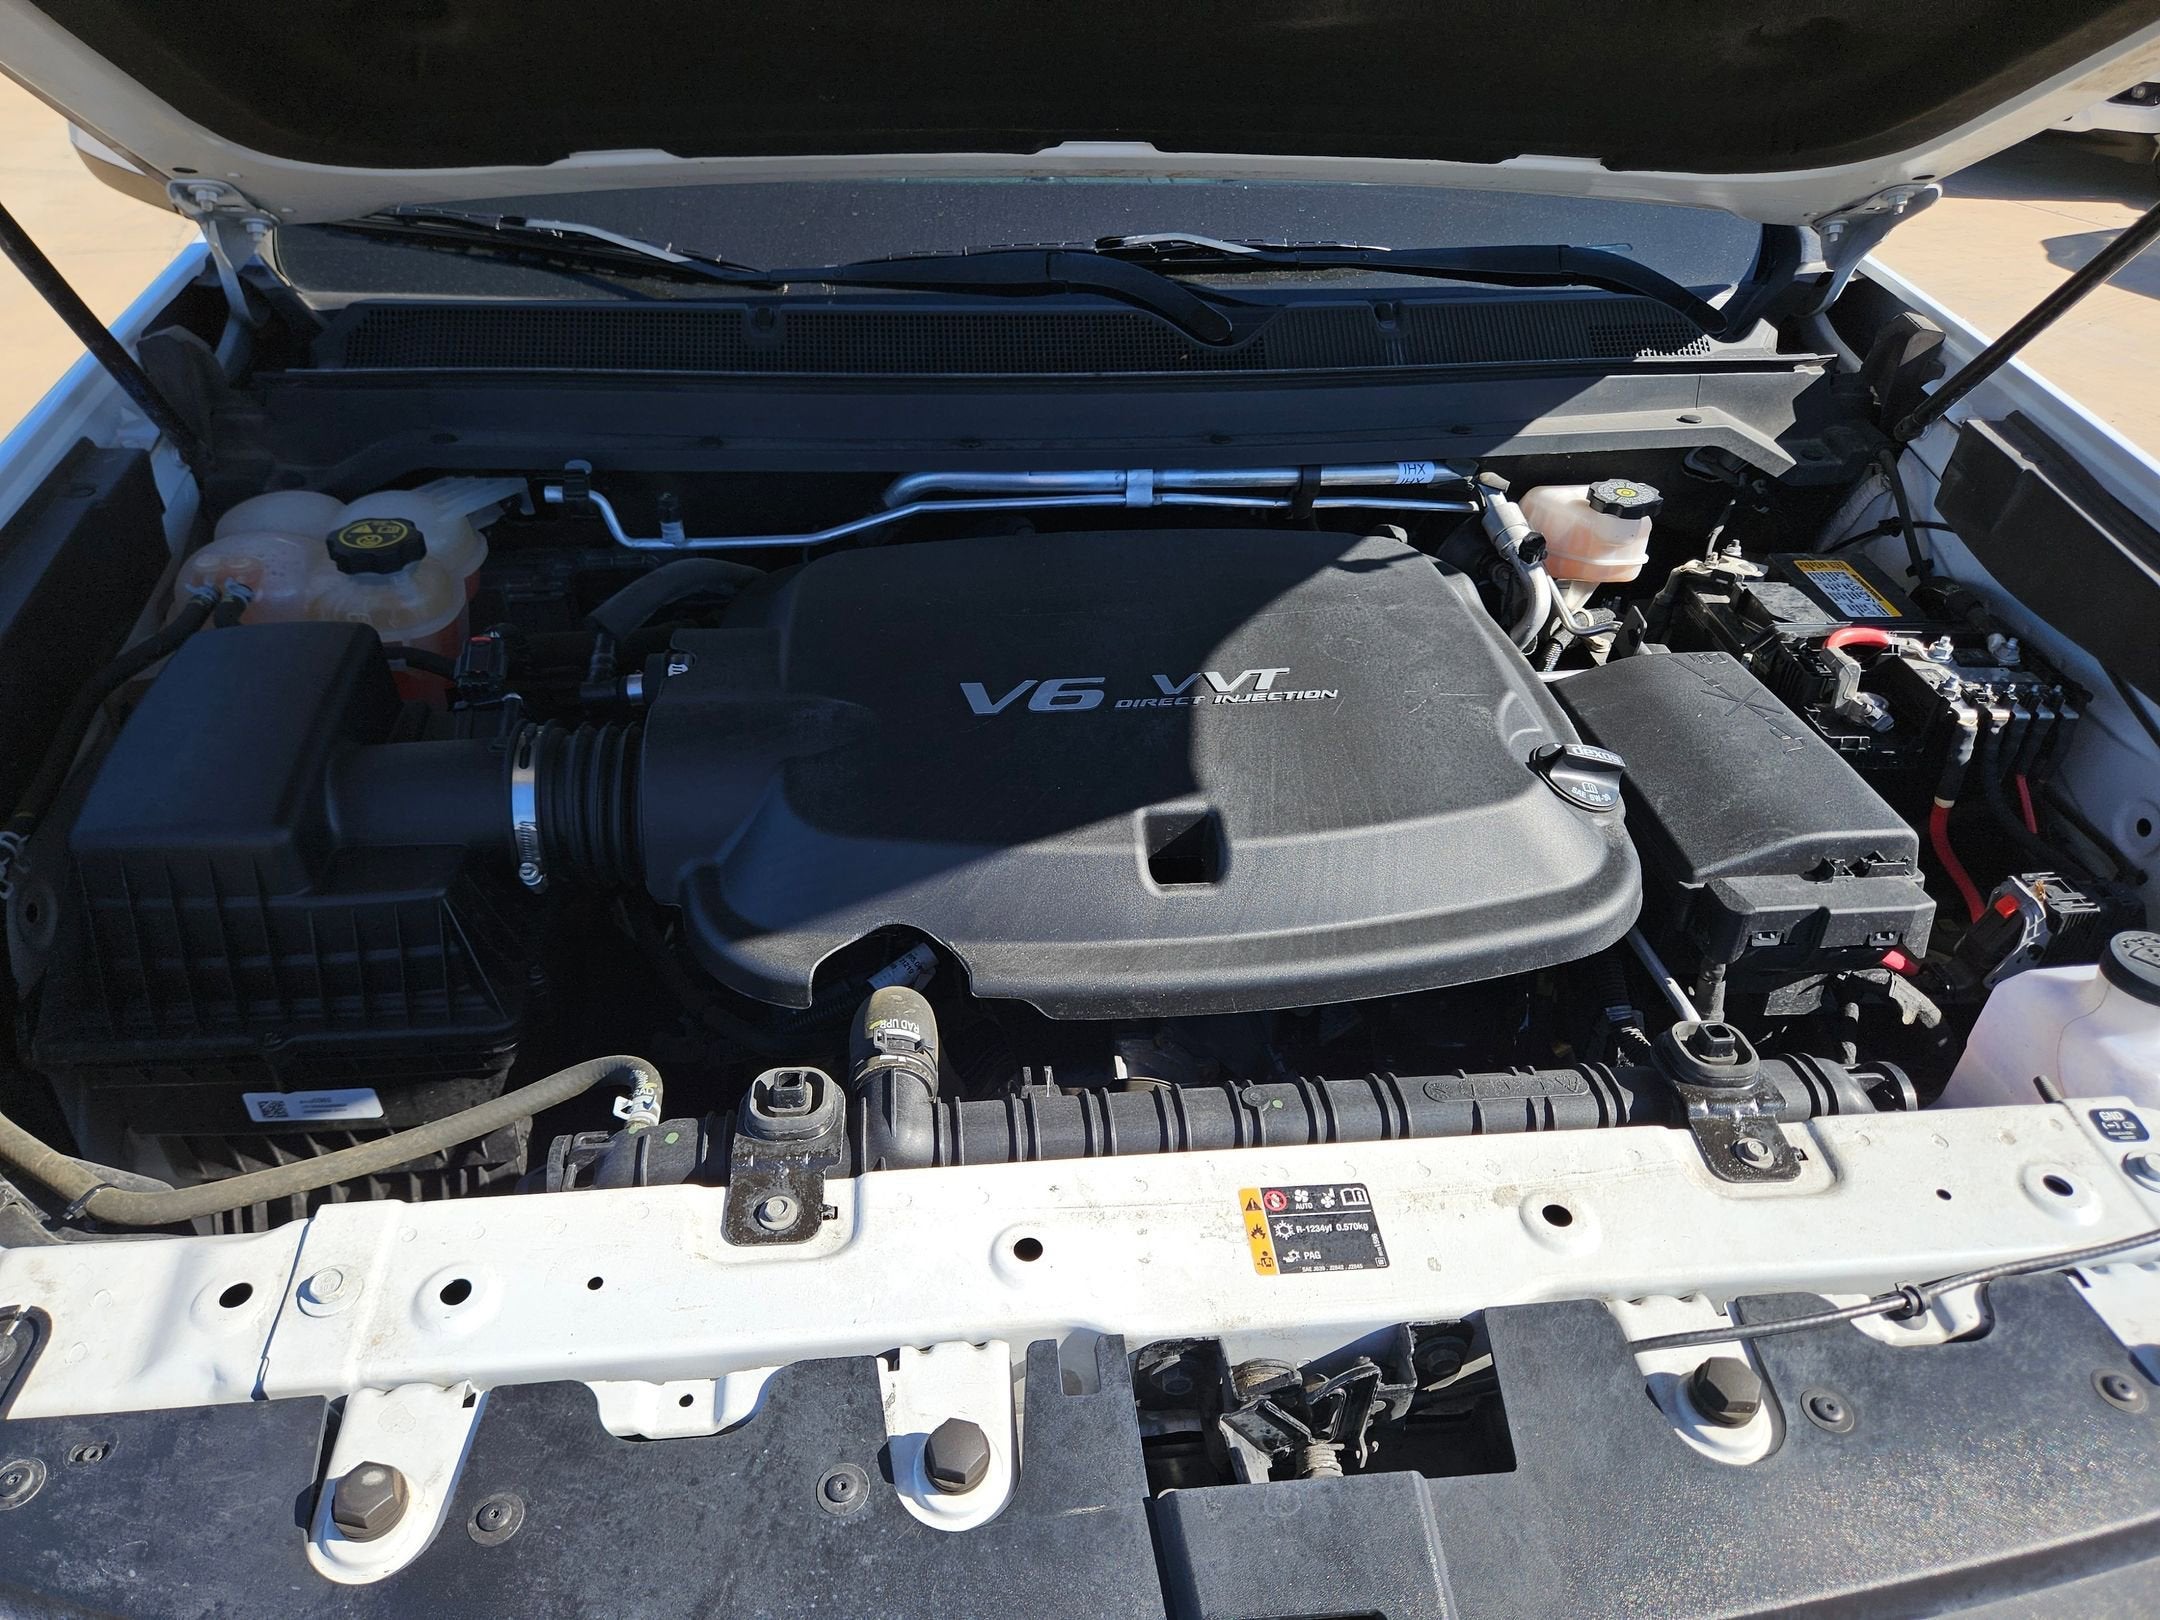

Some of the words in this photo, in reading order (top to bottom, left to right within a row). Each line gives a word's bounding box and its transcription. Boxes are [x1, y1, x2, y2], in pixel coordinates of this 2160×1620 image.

[959, 676, 1105, 716] V6
[1152, 667, 1290, 695] VVT
[1114, 695, 1206, 709] DIRECT
[1212, 689, 1339, 706] INJECTION
[901, 1020, 920, 1033] RAD
[1295, 1202, 1313, 1210] AUTO
[1295, 1224, 1333, 1234] R-1234yf
[1335, 1223, 1369, 1232] 0.570kg
[1303, 1250, 1322, 1260] PAG
